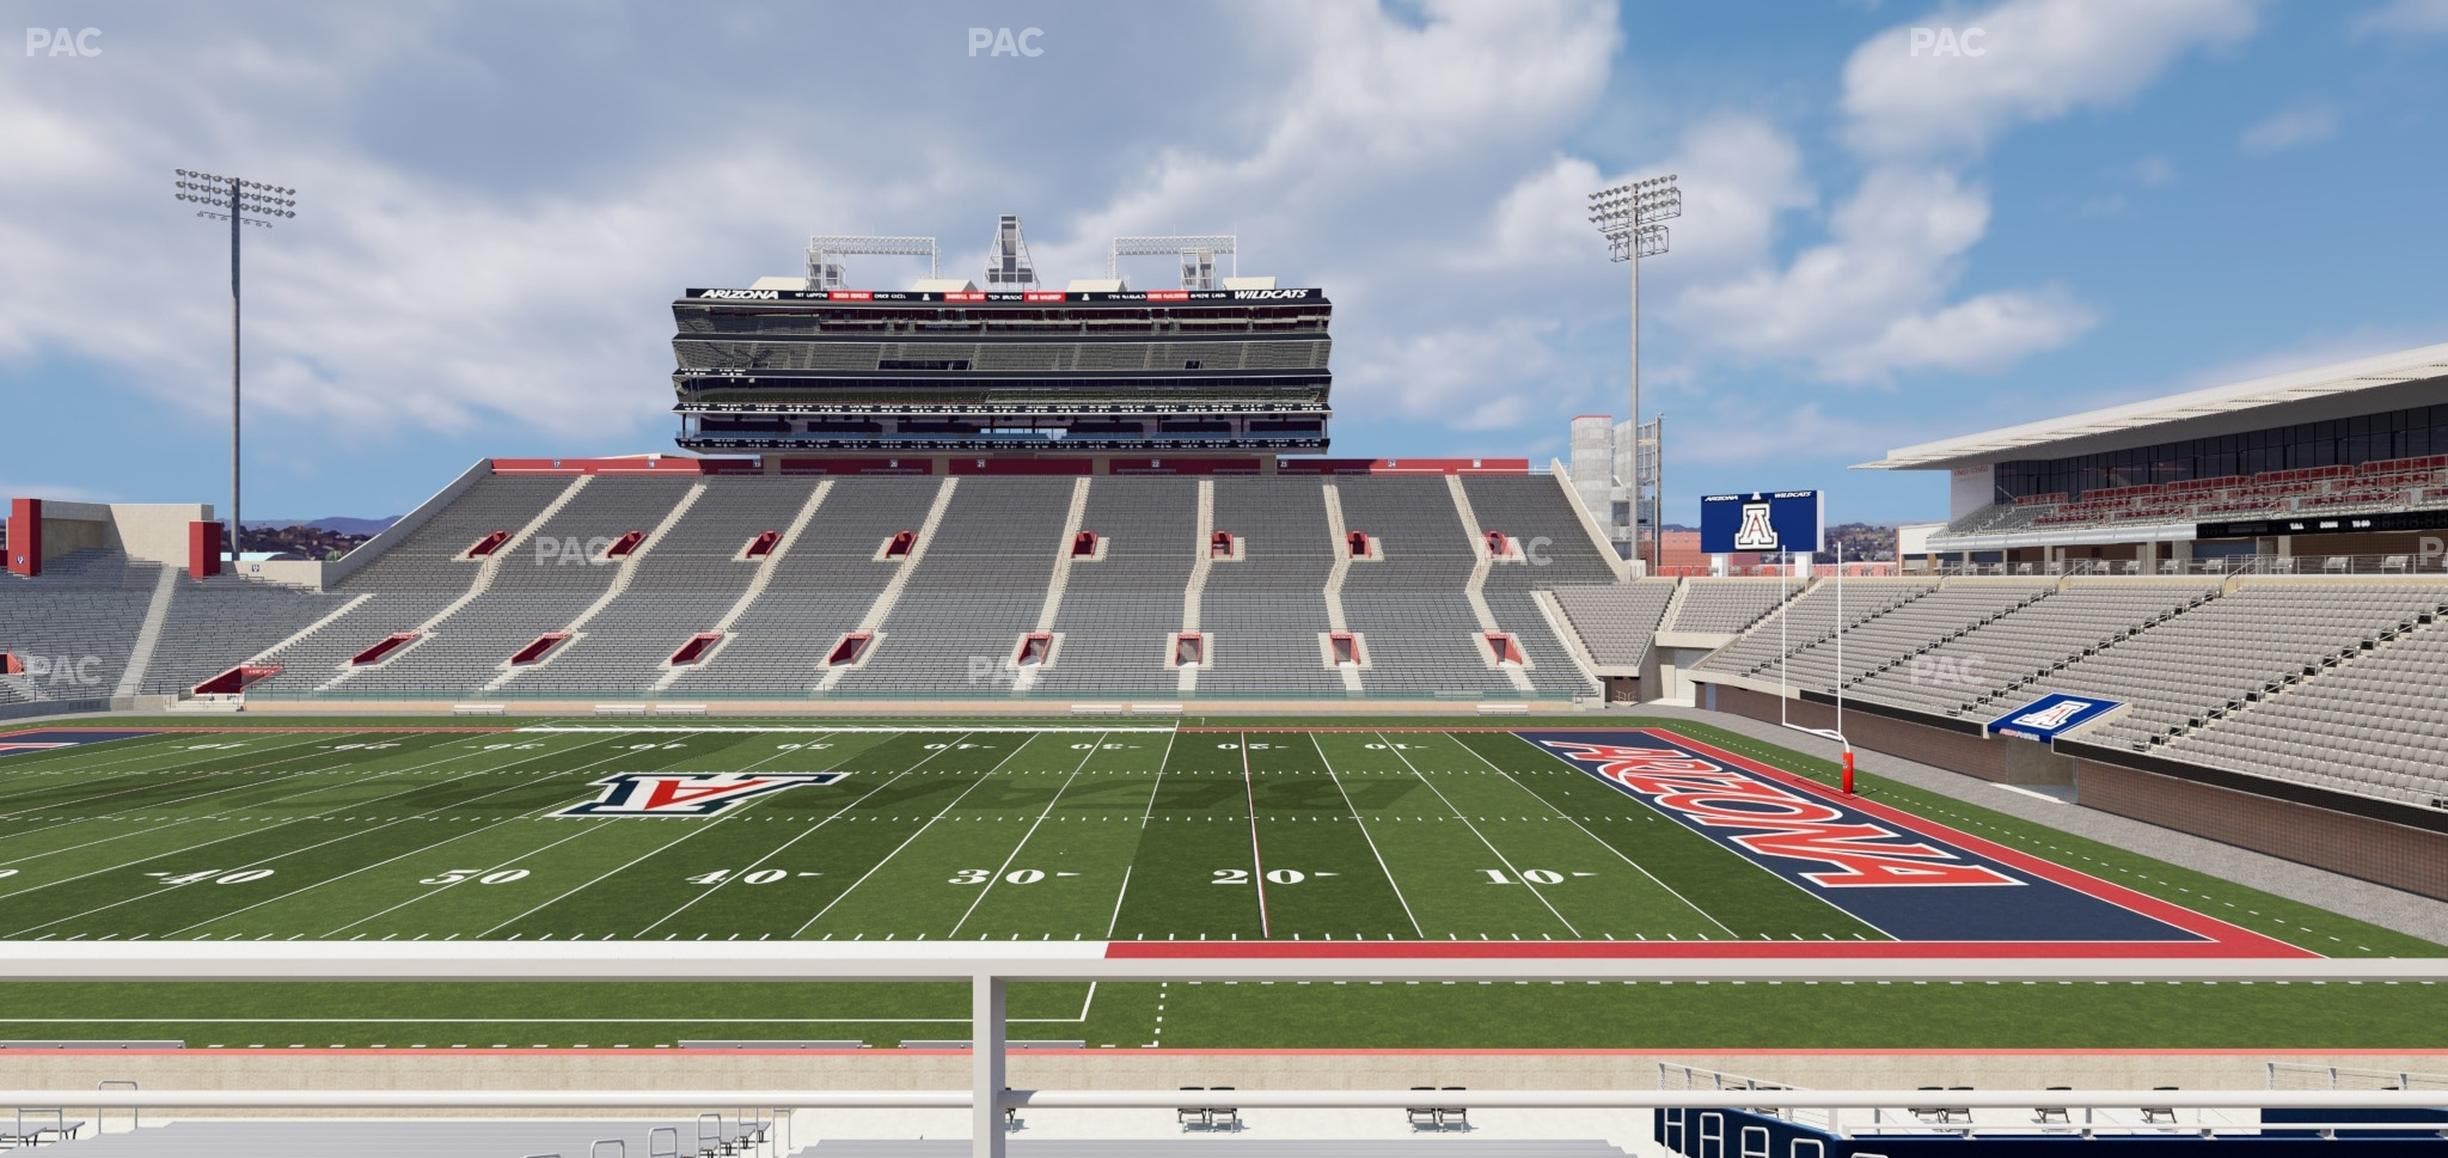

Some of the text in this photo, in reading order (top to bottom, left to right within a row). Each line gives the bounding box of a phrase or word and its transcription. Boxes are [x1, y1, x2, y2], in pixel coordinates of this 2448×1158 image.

[700, 289, 779, 299] ARIZONA
[1234, 289, 1308, 299] WILDCATS
[1735, 503, 1778, 550] A
[2011, 700, 2093, 730] A
[1540, 740, 2028, 886] ARIZONA
